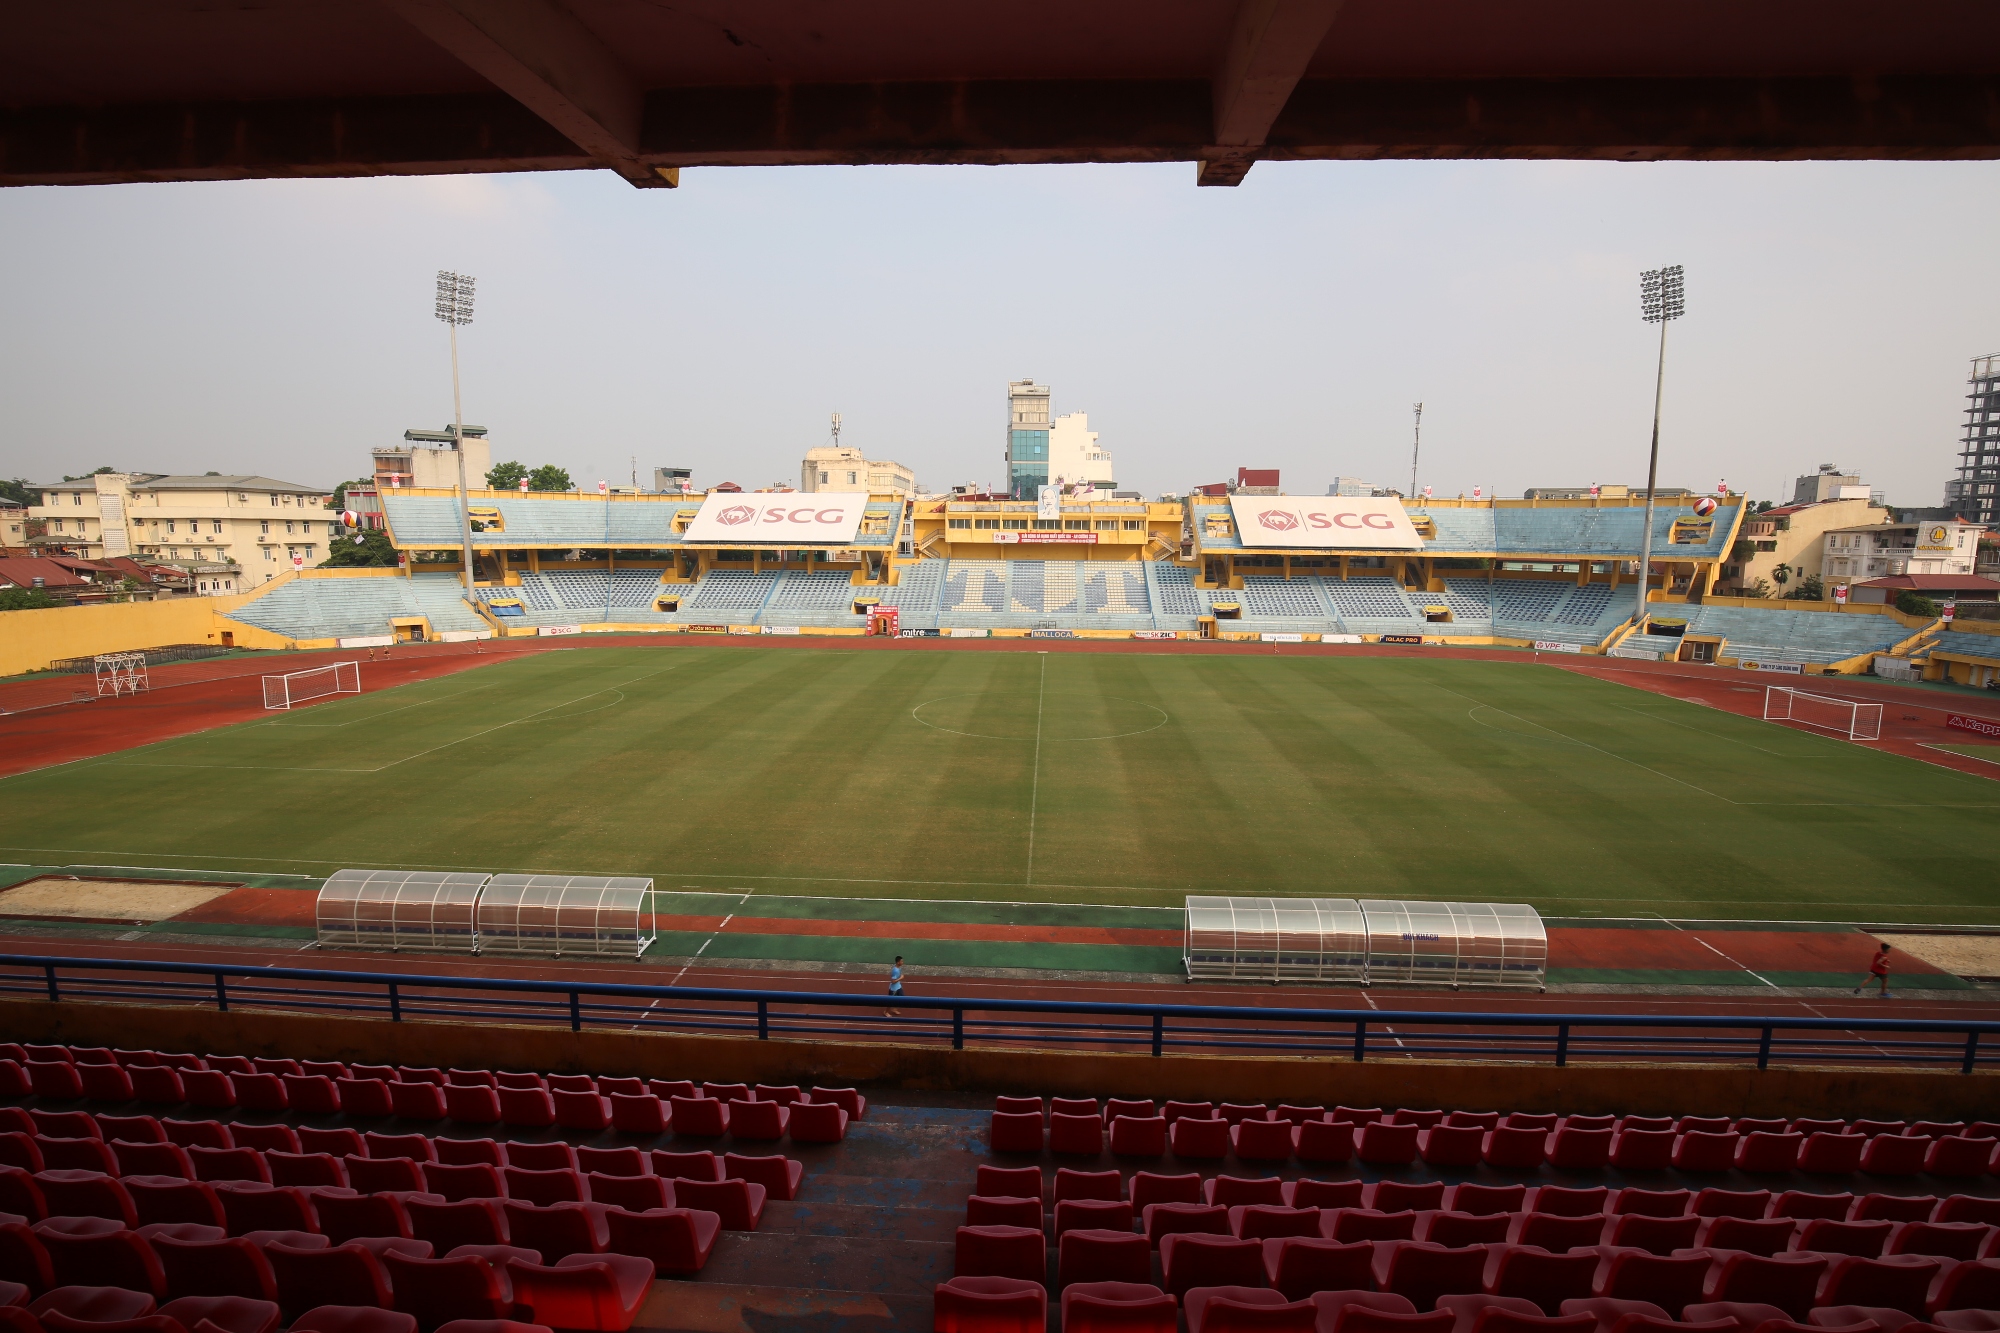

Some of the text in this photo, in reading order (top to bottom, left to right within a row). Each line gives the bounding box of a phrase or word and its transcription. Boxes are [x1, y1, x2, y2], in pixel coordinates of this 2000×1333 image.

[762, 508, 845, 524] SCG
[1307, 512, 1395, 530] SCG
[902, 628, 924, 636] mitre
